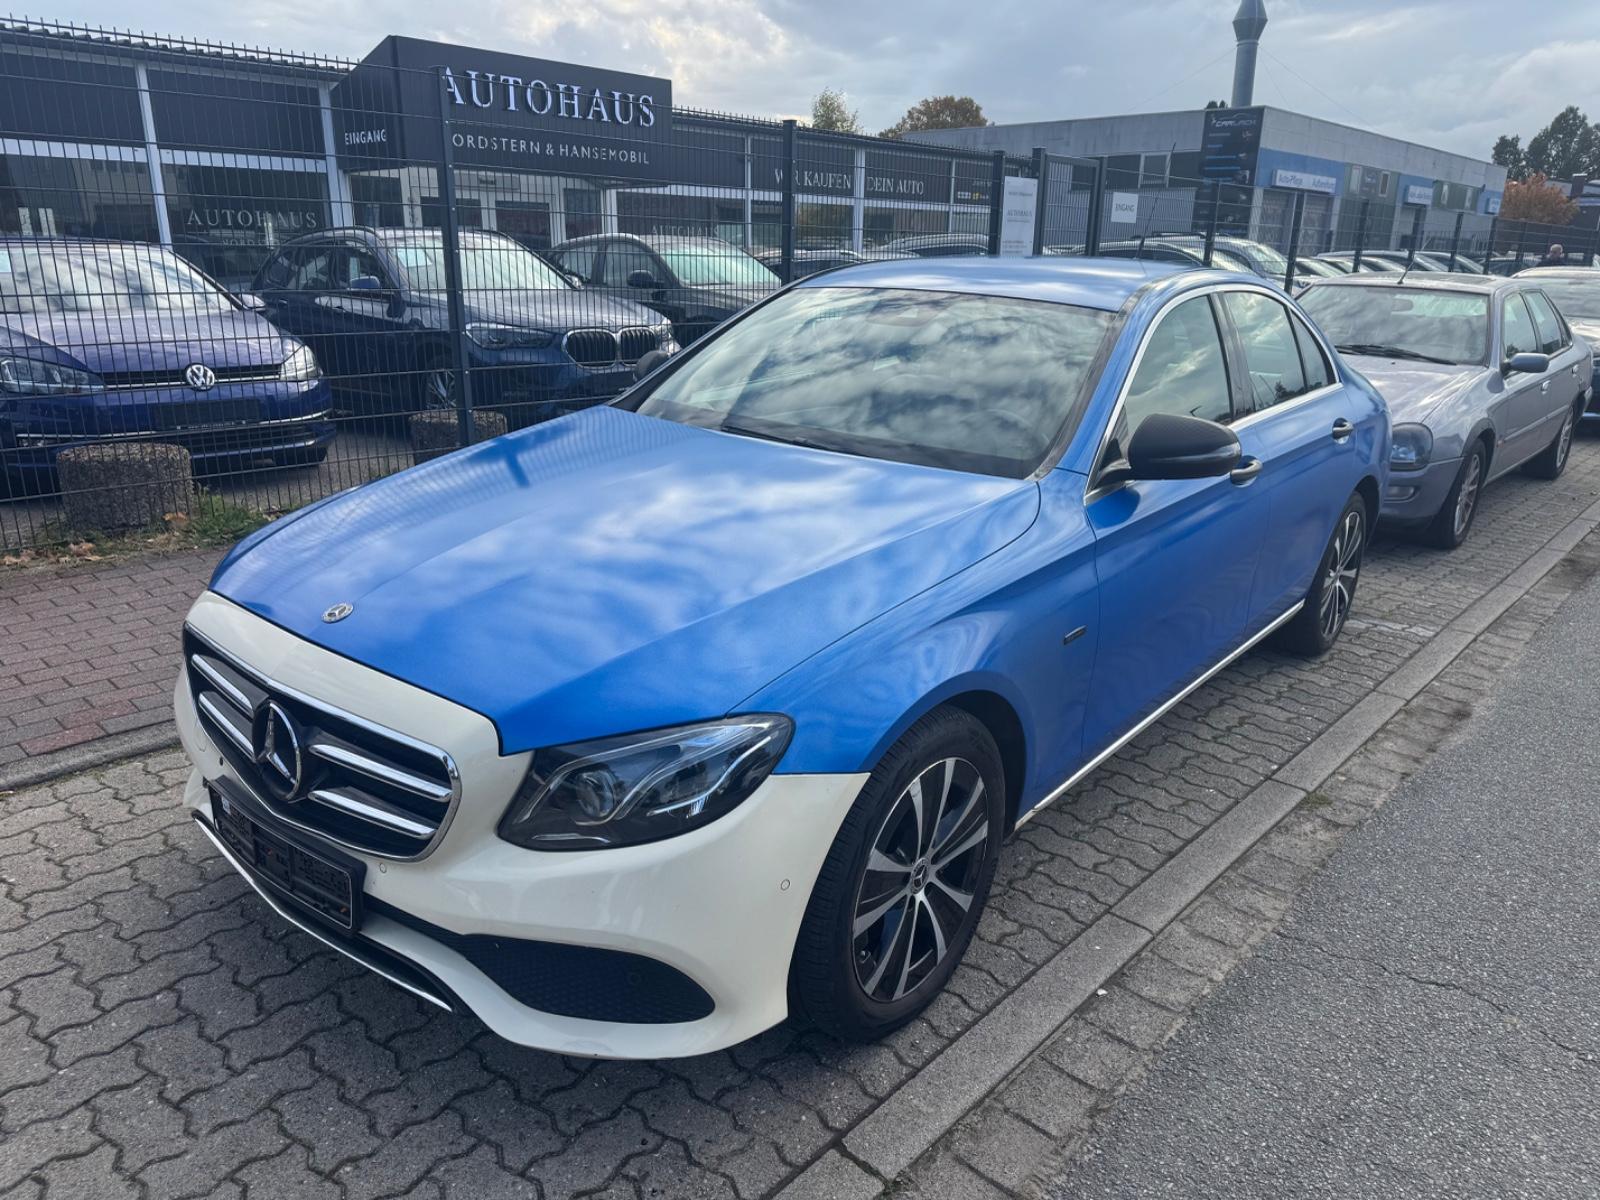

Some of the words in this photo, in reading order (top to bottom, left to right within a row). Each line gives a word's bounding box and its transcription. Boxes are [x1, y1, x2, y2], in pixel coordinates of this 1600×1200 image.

[446, 66, 655, 128] AUTOHAUS
[344, 128, 387, 145] EINGANG
[452, 133, 540, 155] ORDSTERN
[545, 142, 554, 155] &
[559, 143, 649, 165] HANSEMOBIL
[803, 170, 851, 189] KAUFEN
[866, 176, 894, 192] DEIN
[896, 179, 925, 195] AUTO
[187, 208, 317, 229] AUTOHAUS
